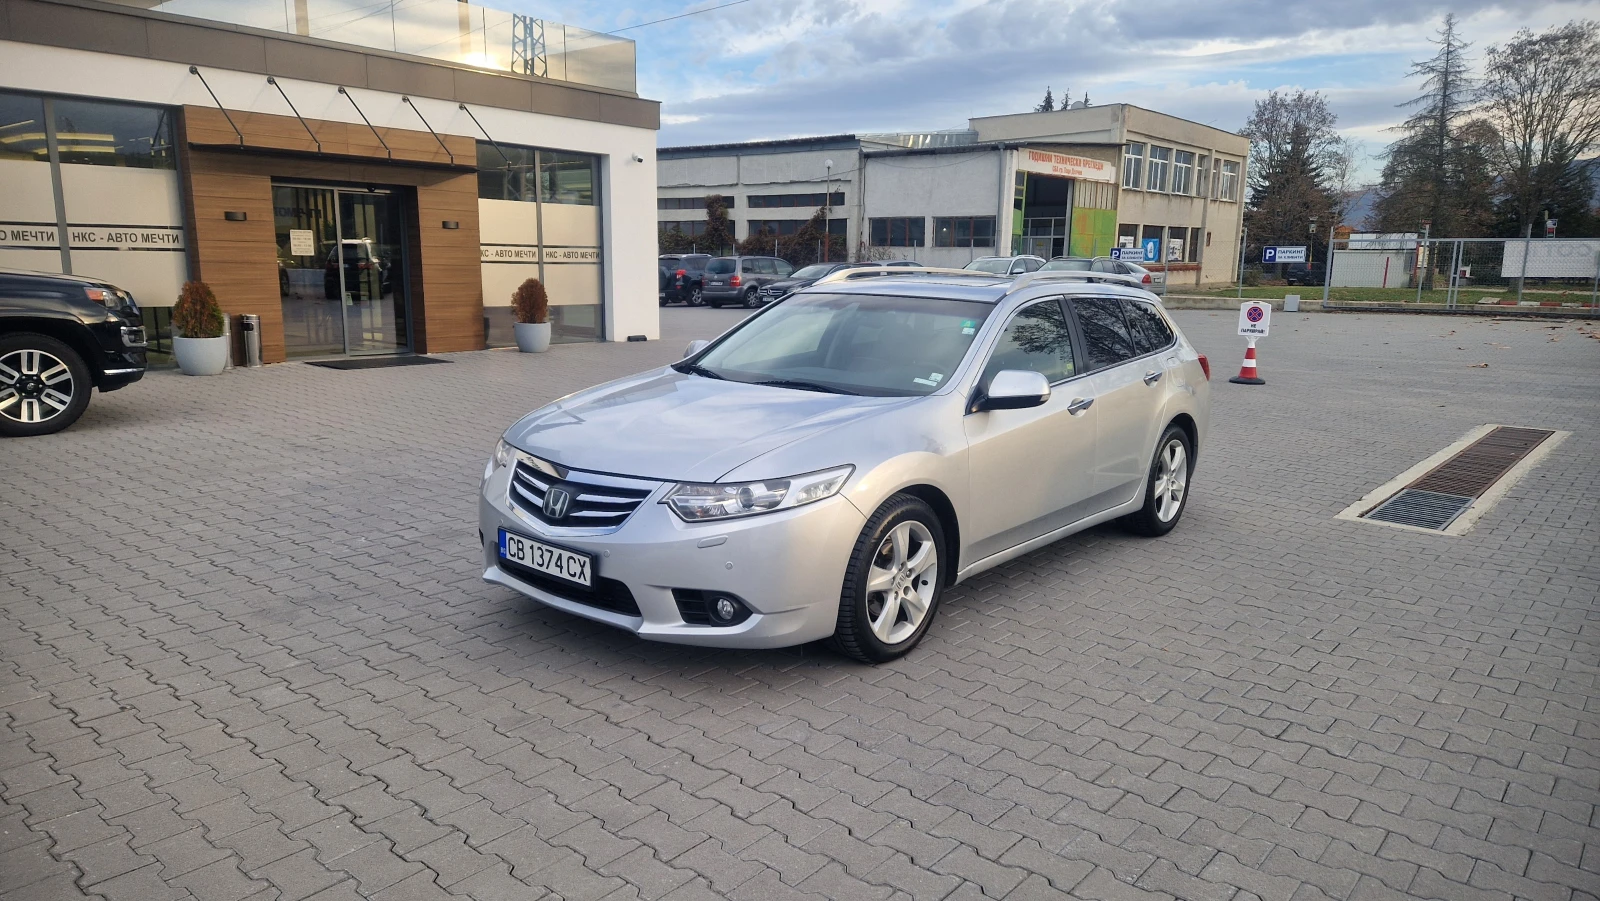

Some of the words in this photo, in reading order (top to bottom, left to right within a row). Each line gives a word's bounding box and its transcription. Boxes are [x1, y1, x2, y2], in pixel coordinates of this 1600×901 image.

[1029, 150, 1053, 163] ГОДИШНИ
[1054, 154, 1081, 167] ТЕХНИЧЕСКИ
[11, 230, 55, 242] МЕЧТИ
[72, 231, 96, 242] НКС
[106, 232, 138, 243] АВТО
[141, 233, 180, 244] МЕЧТИ
[495, 249, 513, 258] АВТО
[514, 250, 536, 259] МЕЧТИ
[545, 251, 558, 259] НКС
[563, 251, 579, 259] АВТО
[580, 251, 600, 259] МЕЧТИ
[508, 536, 525, 561] CB
[529, 544, 564, 574] 1374
[567, 556, 587, 582] CX
